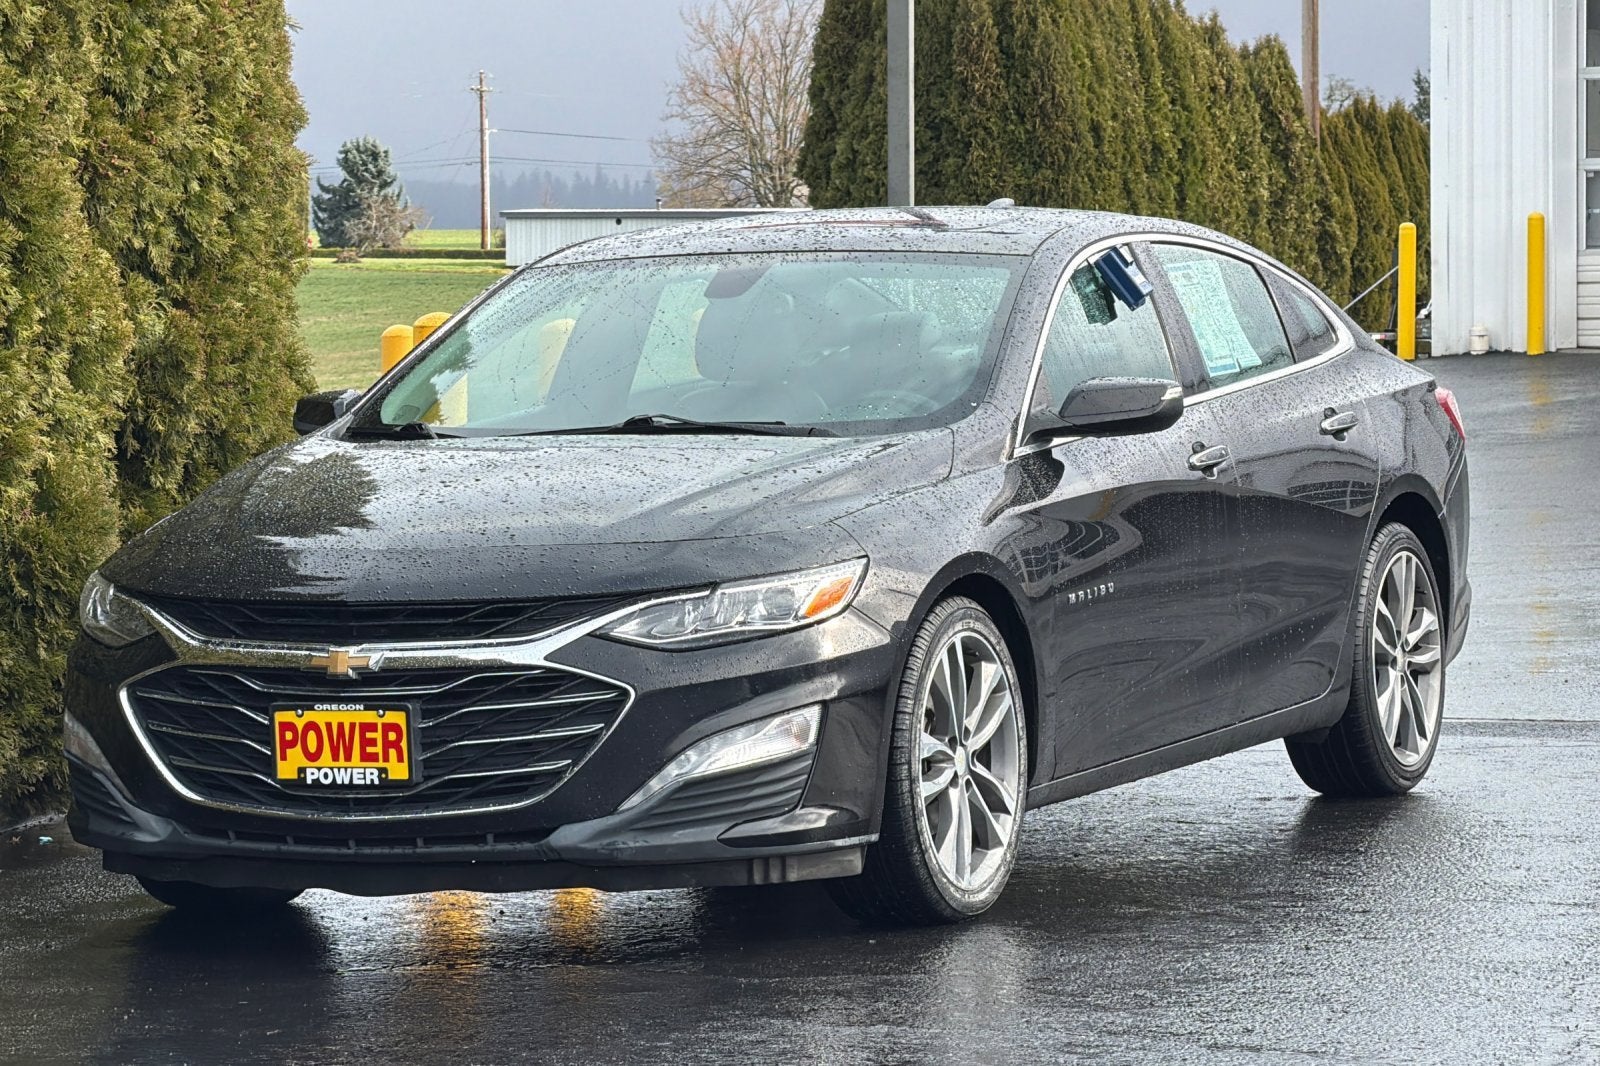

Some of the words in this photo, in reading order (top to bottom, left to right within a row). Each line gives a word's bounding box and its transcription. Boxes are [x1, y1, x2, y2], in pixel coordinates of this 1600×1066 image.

[1068, 582, 1114, 604] MALIBU
[278, 721, 405, 763] POWER
[306, 768, 379, 785] POWER
